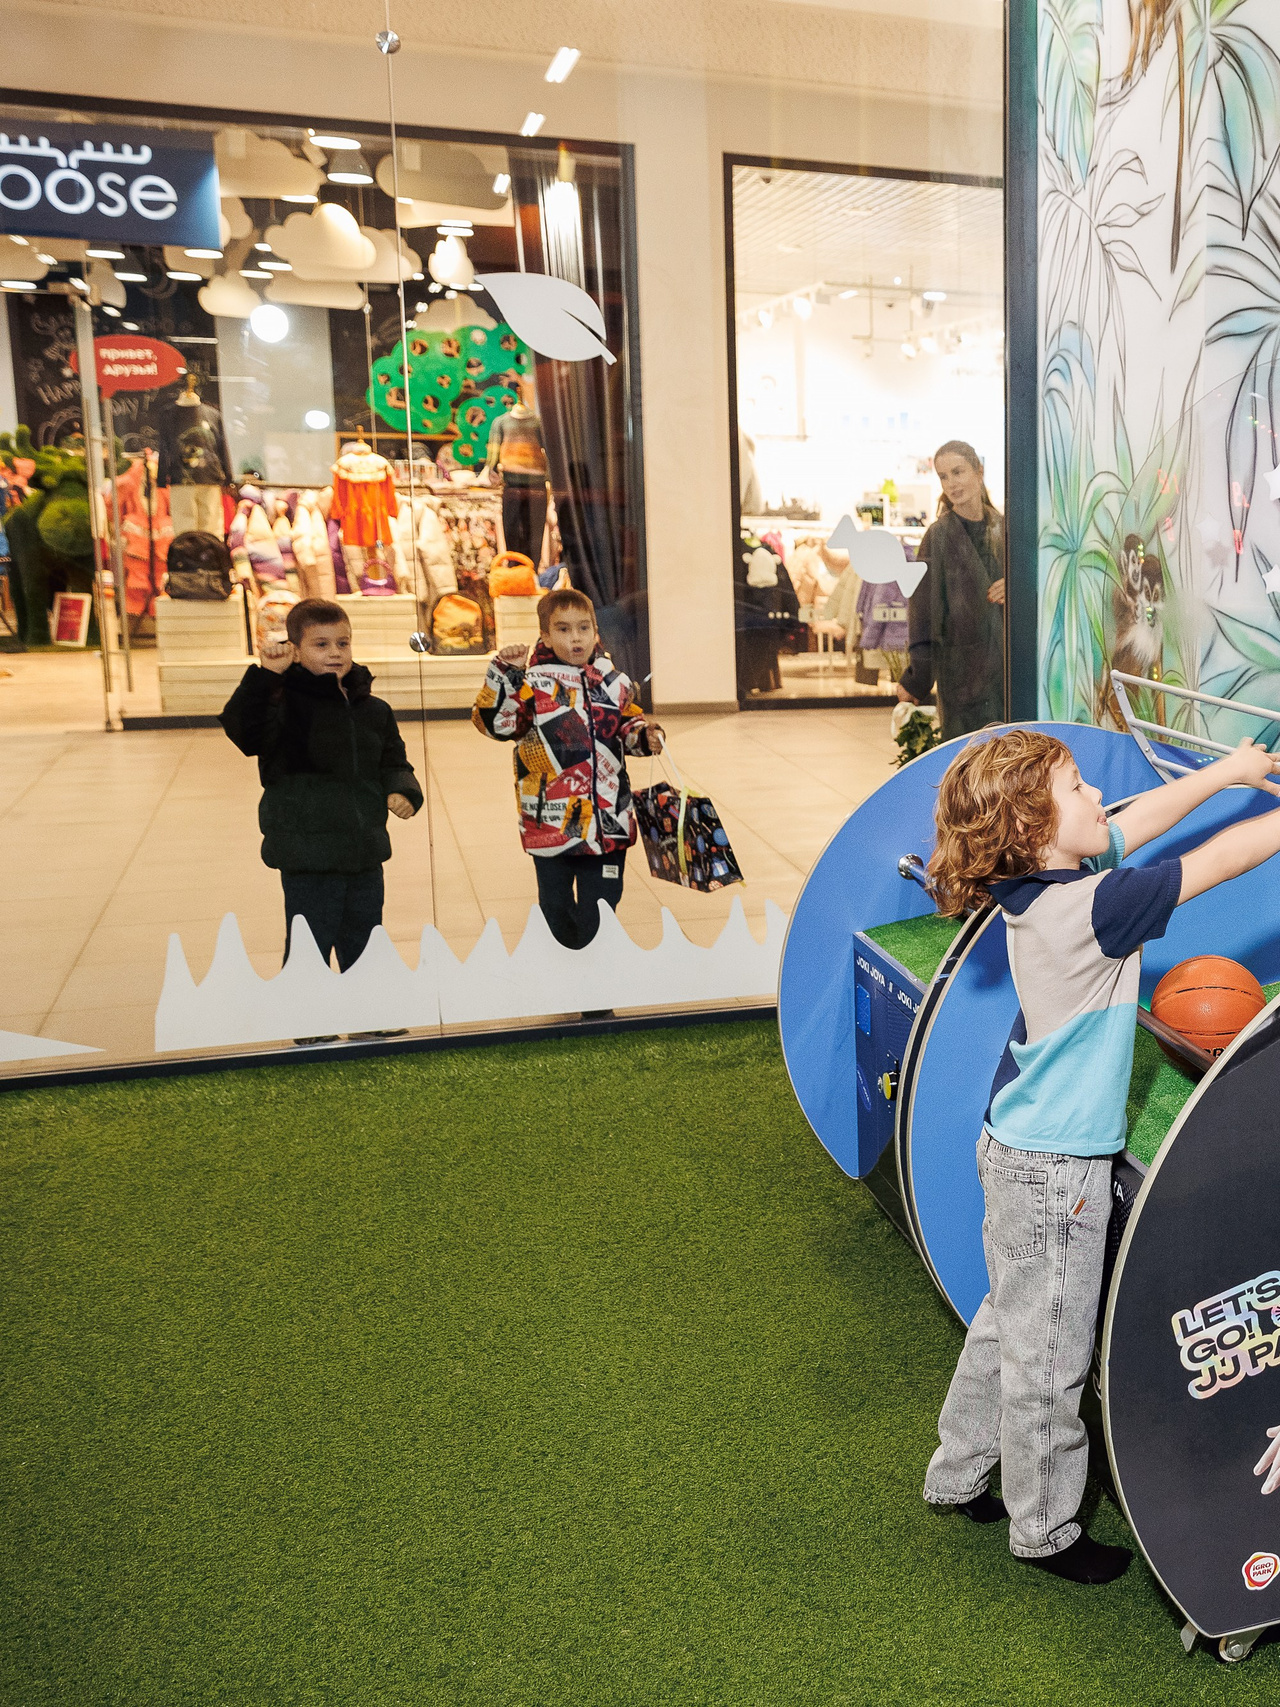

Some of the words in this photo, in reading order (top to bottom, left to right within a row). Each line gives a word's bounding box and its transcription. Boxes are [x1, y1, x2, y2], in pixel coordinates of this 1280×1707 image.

[0, 164, 178, 220] oose
[563, 768, 589, 793] 21
[856, 956, 870, 974] JOKI
[870, 966, 886, 988] JOYA
[896, 989, 912, 1010] JOKI
[1186, 1316, 1257, 1364] GO!
[1194, 1354, 1242, 1392] JJ
[1252, 1567, 1272, 1577] PARK
